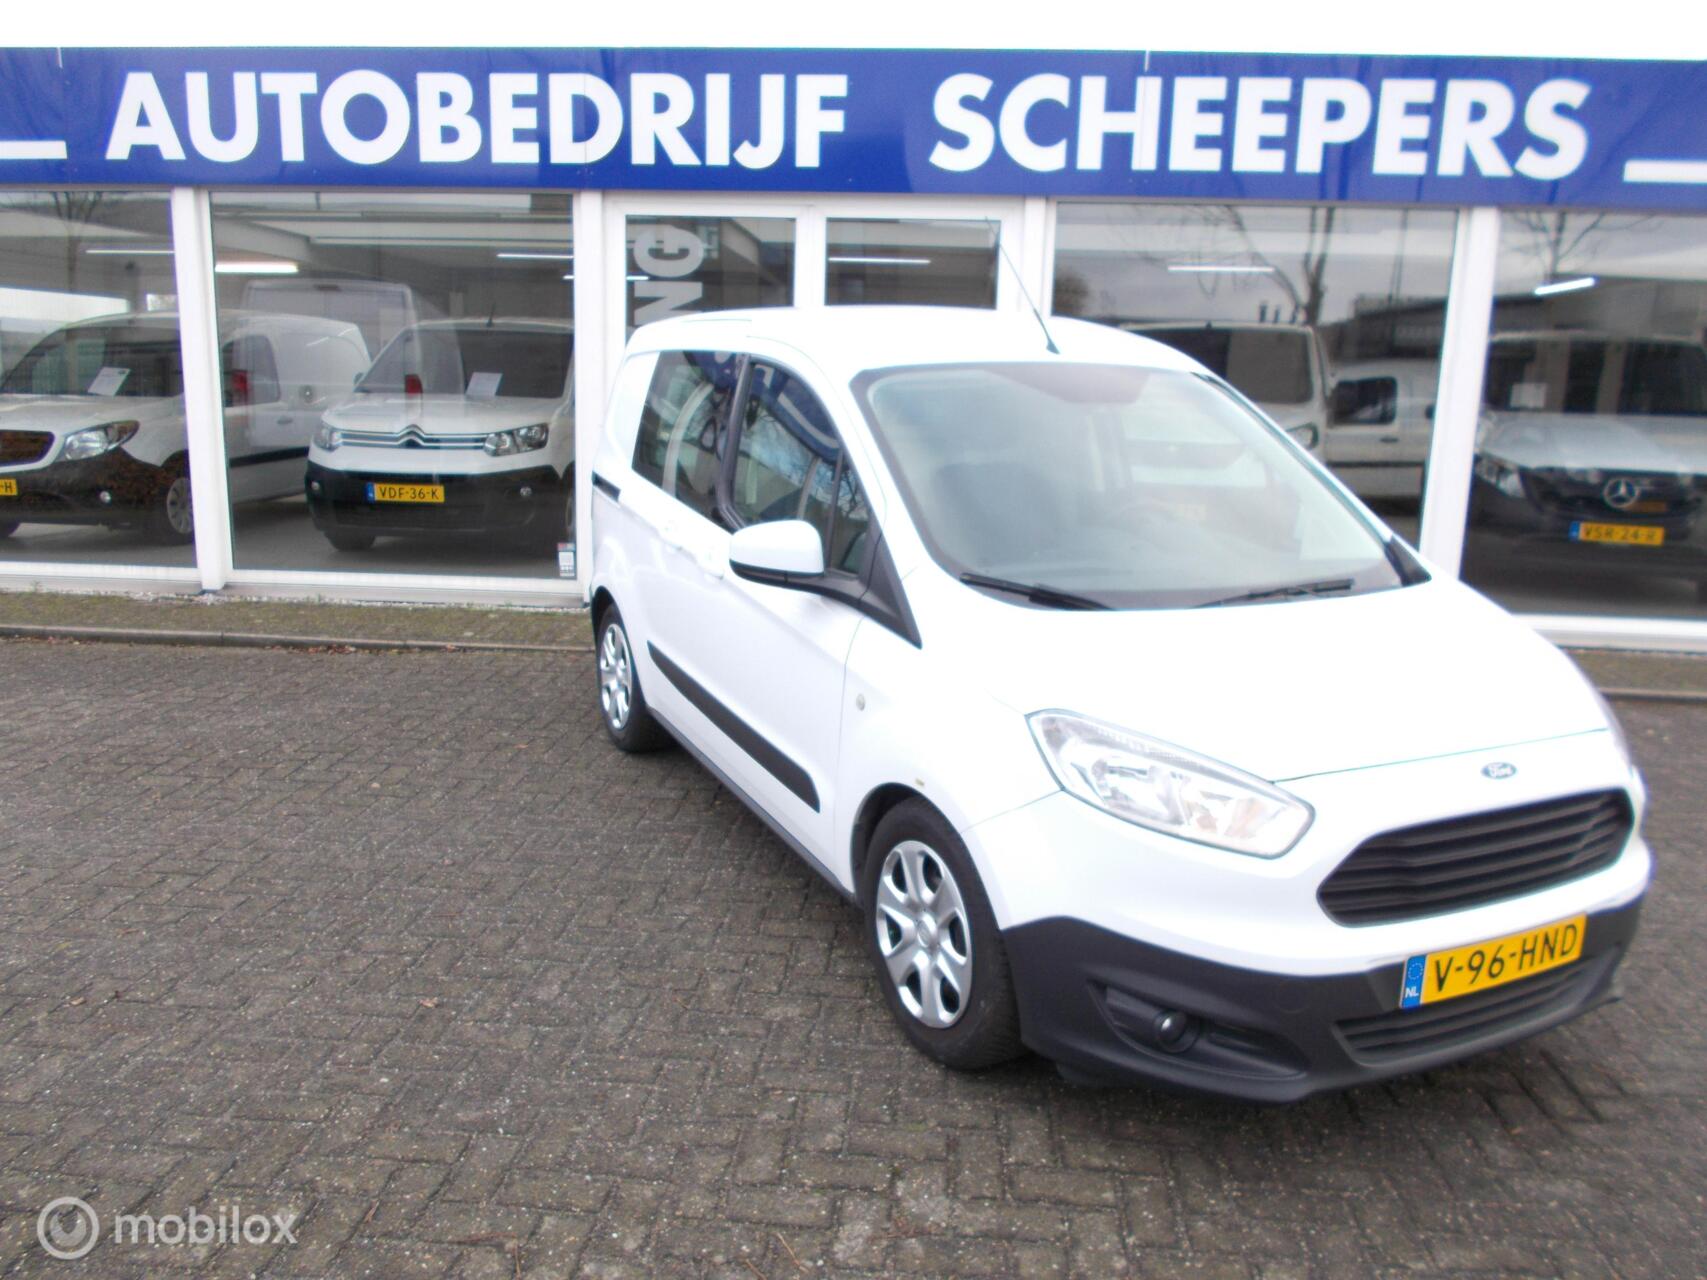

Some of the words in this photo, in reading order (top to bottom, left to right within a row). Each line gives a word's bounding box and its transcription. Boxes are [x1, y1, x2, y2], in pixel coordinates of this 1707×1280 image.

[105, 70, 848, 170] AUTOBEDRIJF
[929, 73, 1589, 180] SCHEEPERS
[379, 486, 440, 500] VDF-36-K
[1434, 923, 1578, 993] V-96-HND
[1404, 986, 1420, 999] NL
